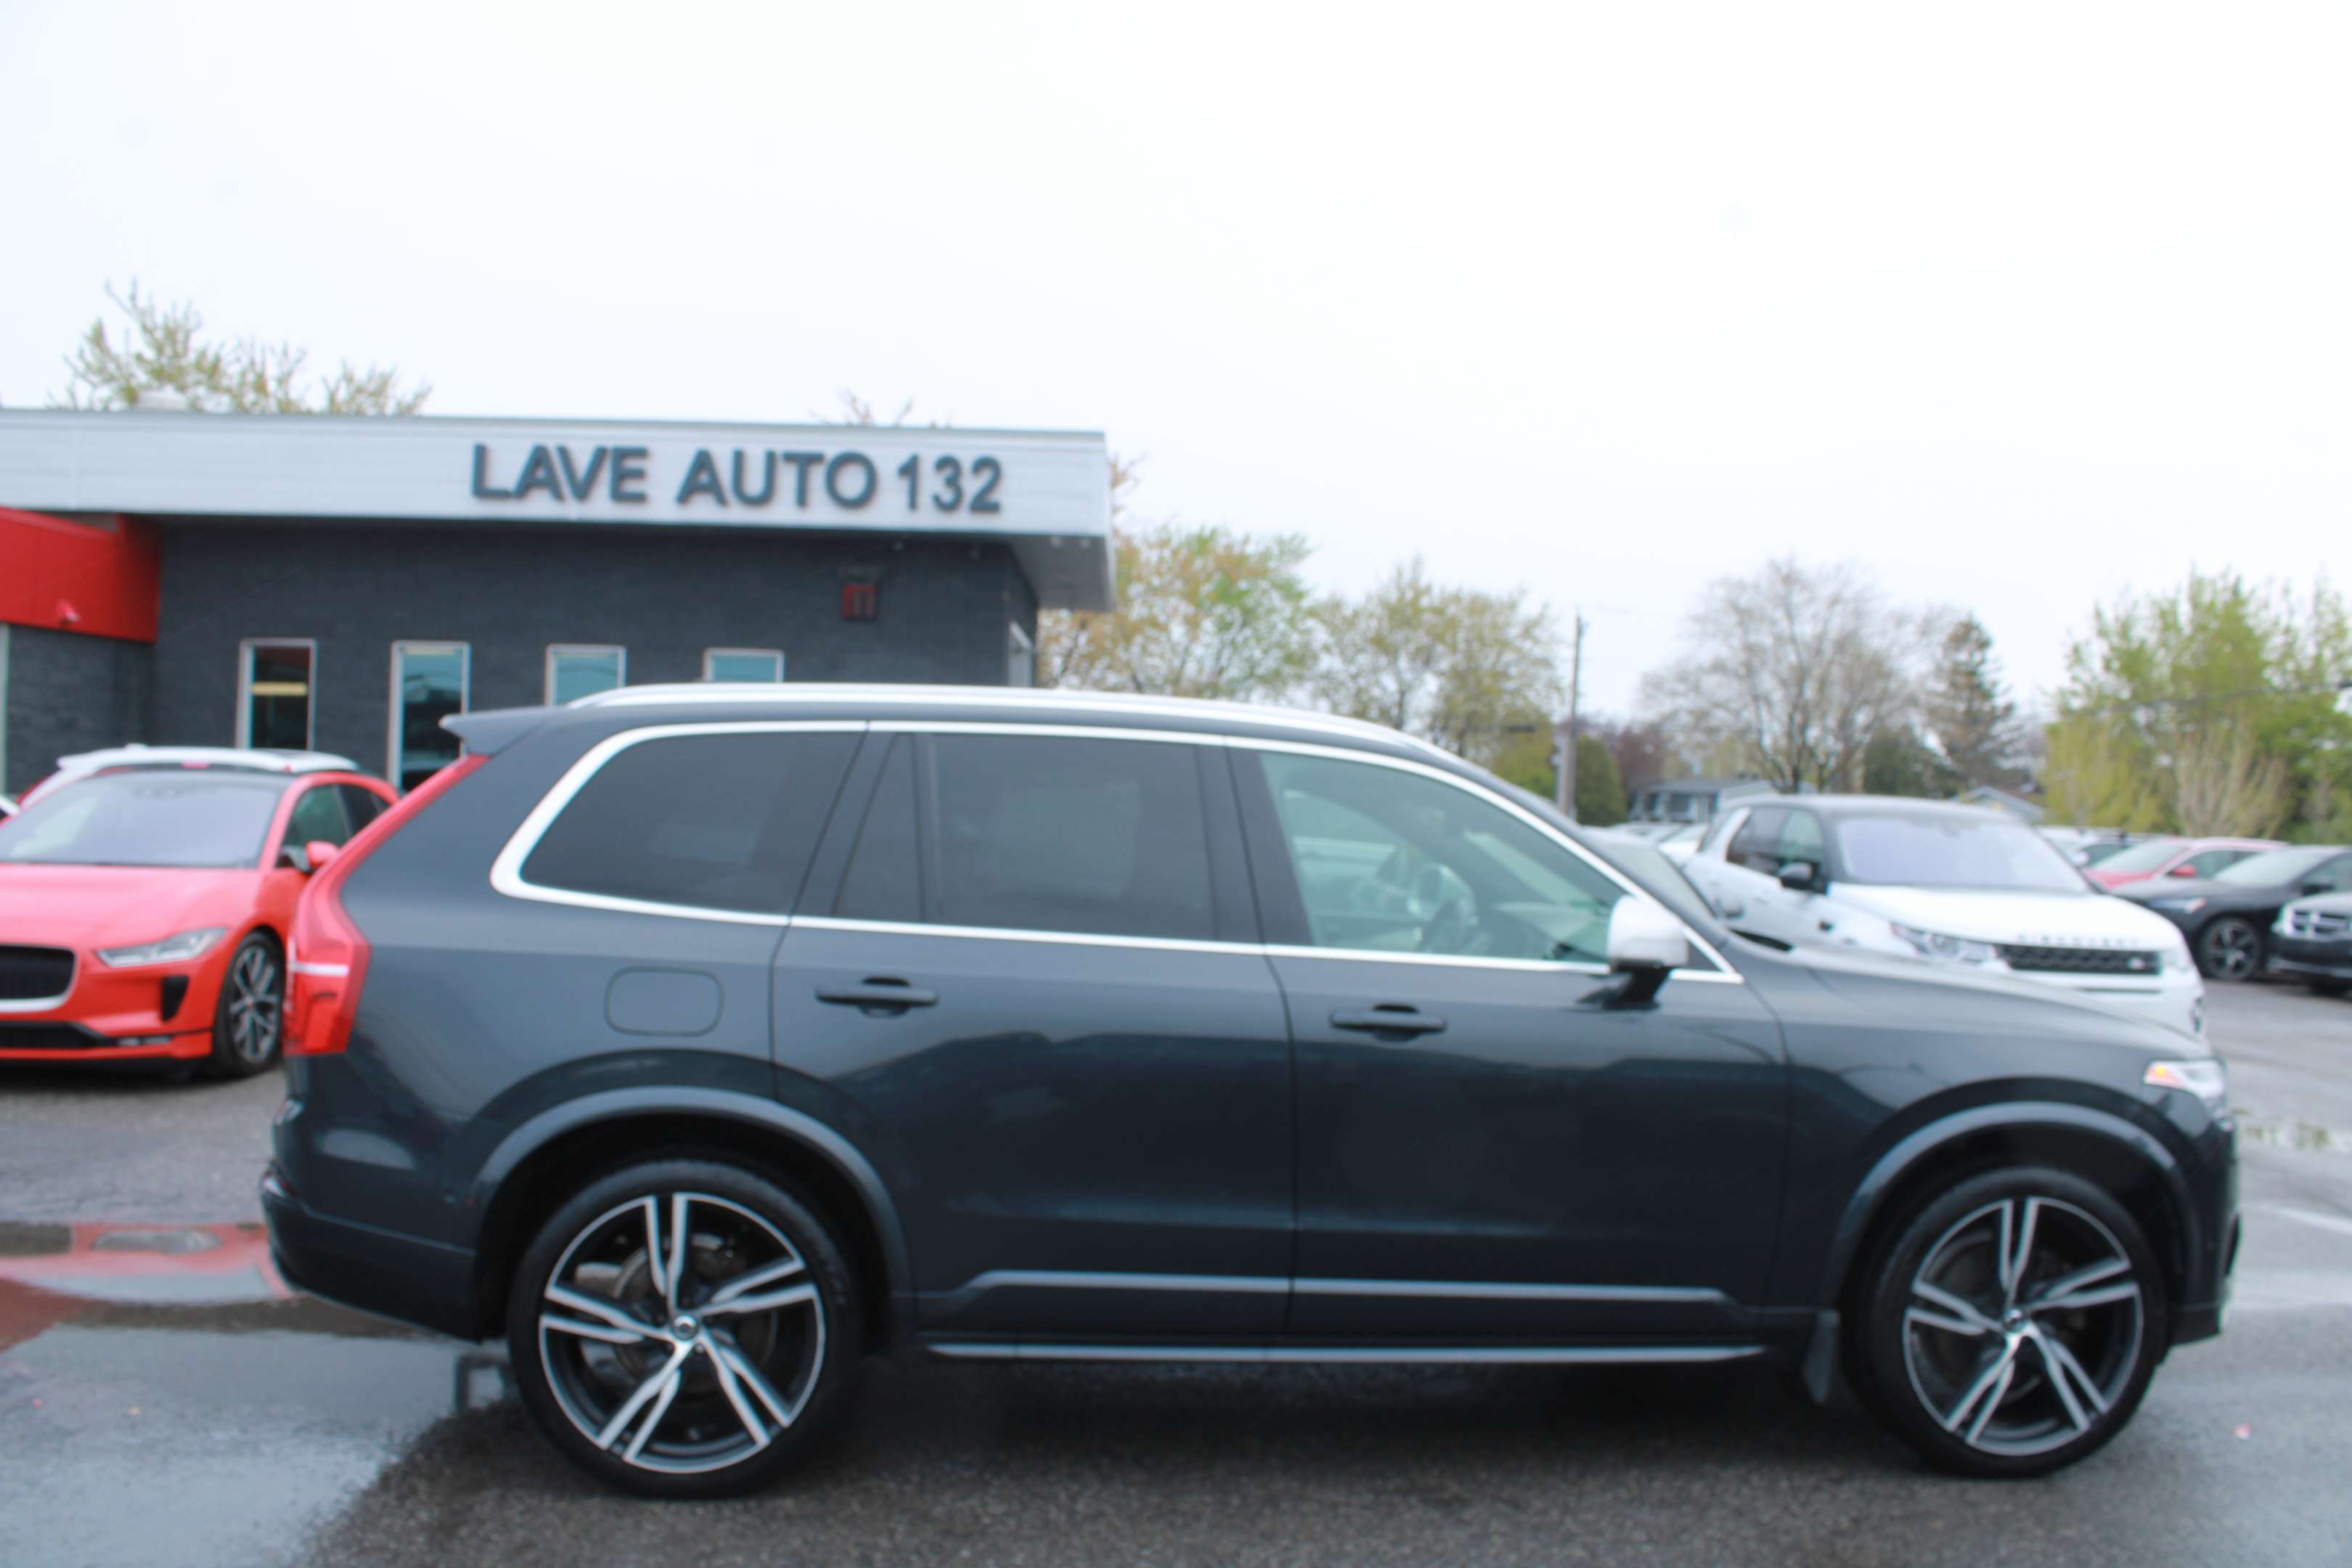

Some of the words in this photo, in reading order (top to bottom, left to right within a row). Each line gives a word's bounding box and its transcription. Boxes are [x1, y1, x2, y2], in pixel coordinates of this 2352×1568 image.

[471, 444, 648, 502] LAVE
[676, 449, 878, 509] AUTO
[897, 454, 1002, 513] 132
